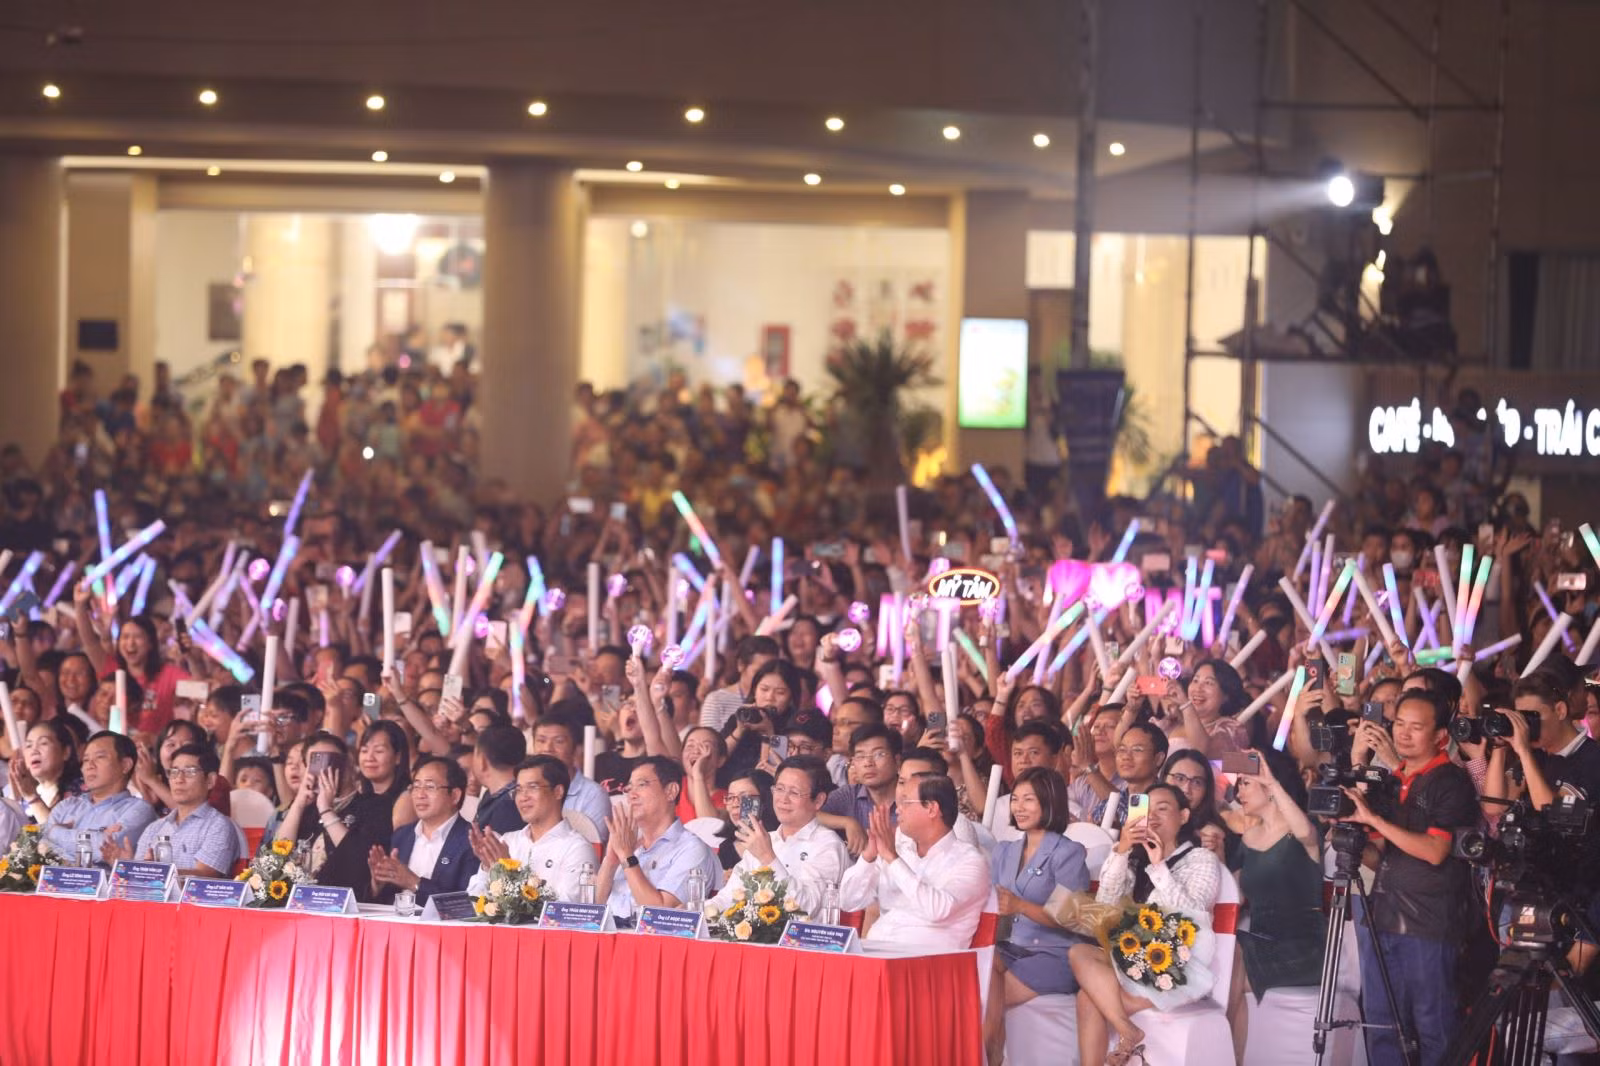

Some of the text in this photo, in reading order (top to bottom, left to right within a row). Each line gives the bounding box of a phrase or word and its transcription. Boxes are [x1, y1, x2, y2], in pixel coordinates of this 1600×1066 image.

[1369, 398, 1421, 453] CAFÉ
[1534, 400, 1583, 455] TRÁI
[962, 575, 994, 599] TÂM
